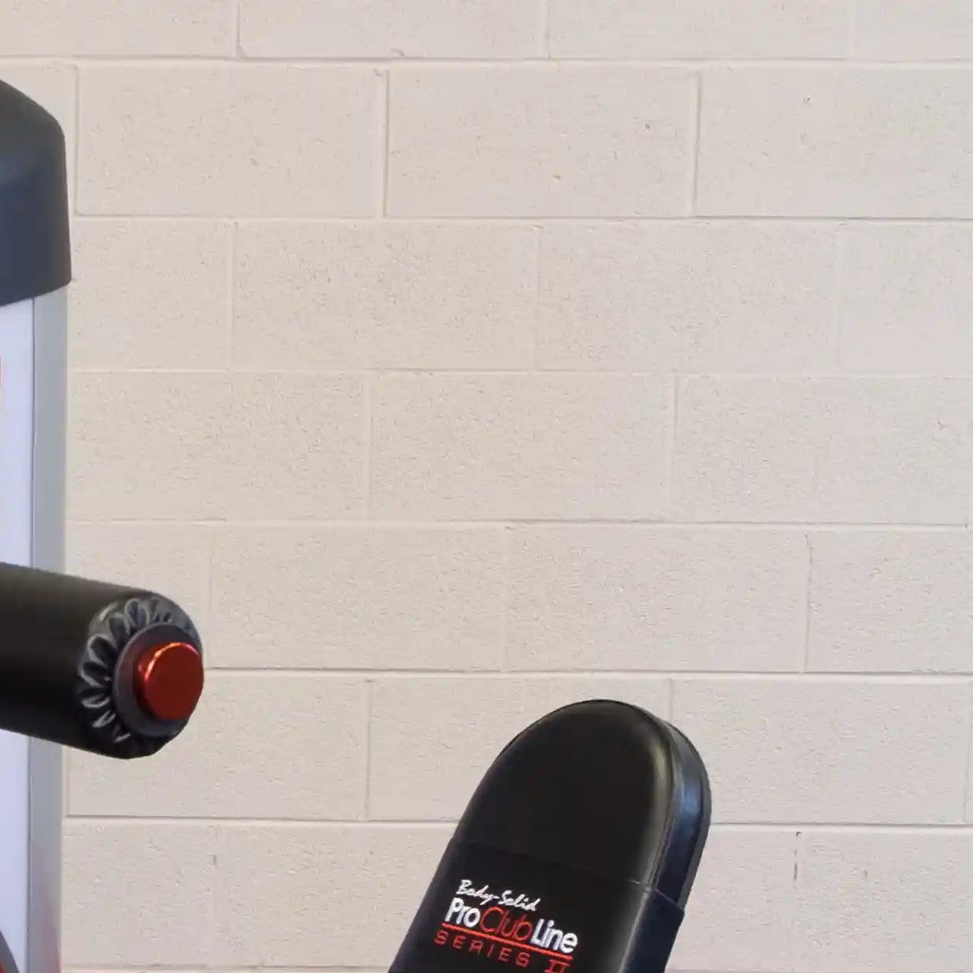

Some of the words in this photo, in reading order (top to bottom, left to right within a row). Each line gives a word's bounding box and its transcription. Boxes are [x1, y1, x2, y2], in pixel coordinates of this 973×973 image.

[455, 879, 541, 912] Body-Solid
[444, 897, 578, 953] ProClubLine
[434, 930, 531, 968] SERIES
